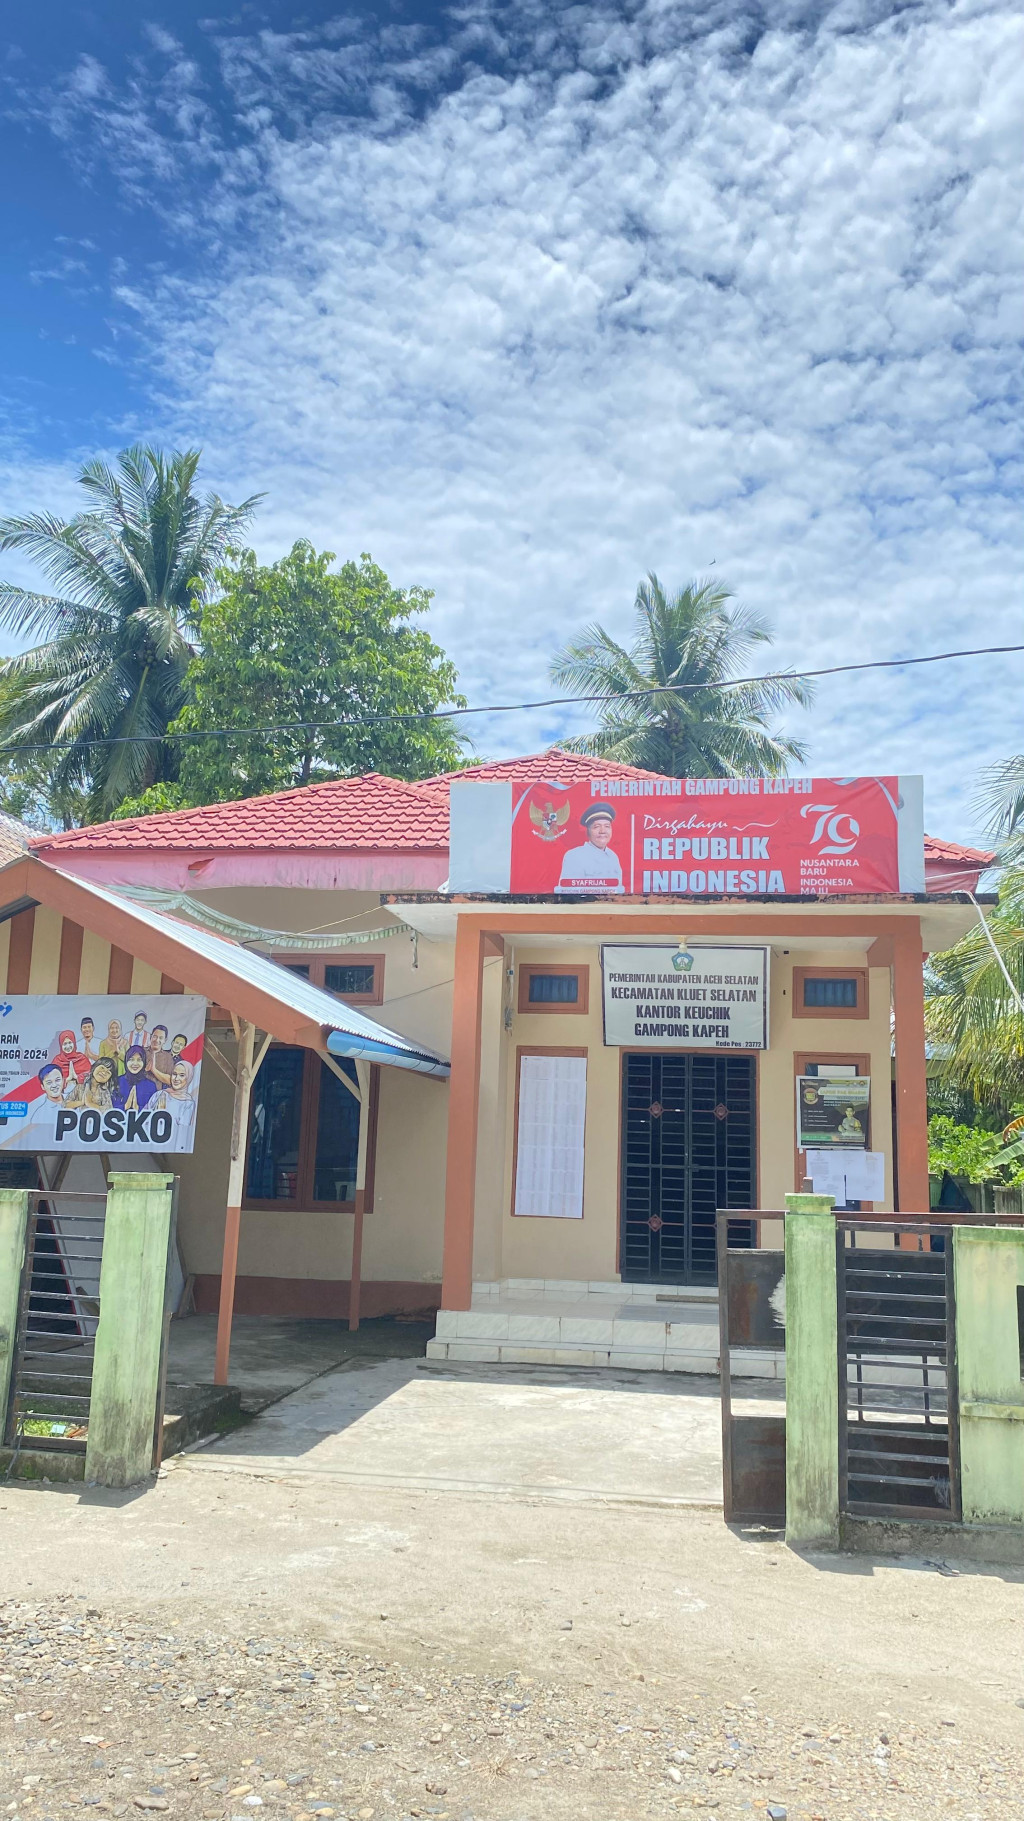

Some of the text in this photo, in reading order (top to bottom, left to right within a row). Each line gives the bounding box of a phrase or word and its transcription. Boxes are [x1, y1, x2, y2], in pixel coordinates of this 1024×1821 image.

[590, 778, 813, 797] PEMERINTAH GAMPONG KAPEH
[643, 814, 728, 835] Dirgahayu
[643, 836, 770, 860] REPUBLIK
[800, 859, 860, 867] NUSANTARA
[800, 867, 827, 876] BARU
[642, 869, 787, 893] INDONESIA
[800, 878, 854, 886] INDONESIA
[609, 973, 759, 986] PEMERINTAH KABUPATEN ACEH SELATAN
[611, 986, 757, 1002] KECAMATAN KLUET SELATAN
[636, 1004, 731, 1020] KANTOR KEUCHIK
[634, 1023, 729, 1038] GAMPONG KAPEH
[23, 1049, 48, 1060] 2024
[10, 1102, 26, 1110] 2024
[55, 1109, 173, 1144] POSKO
